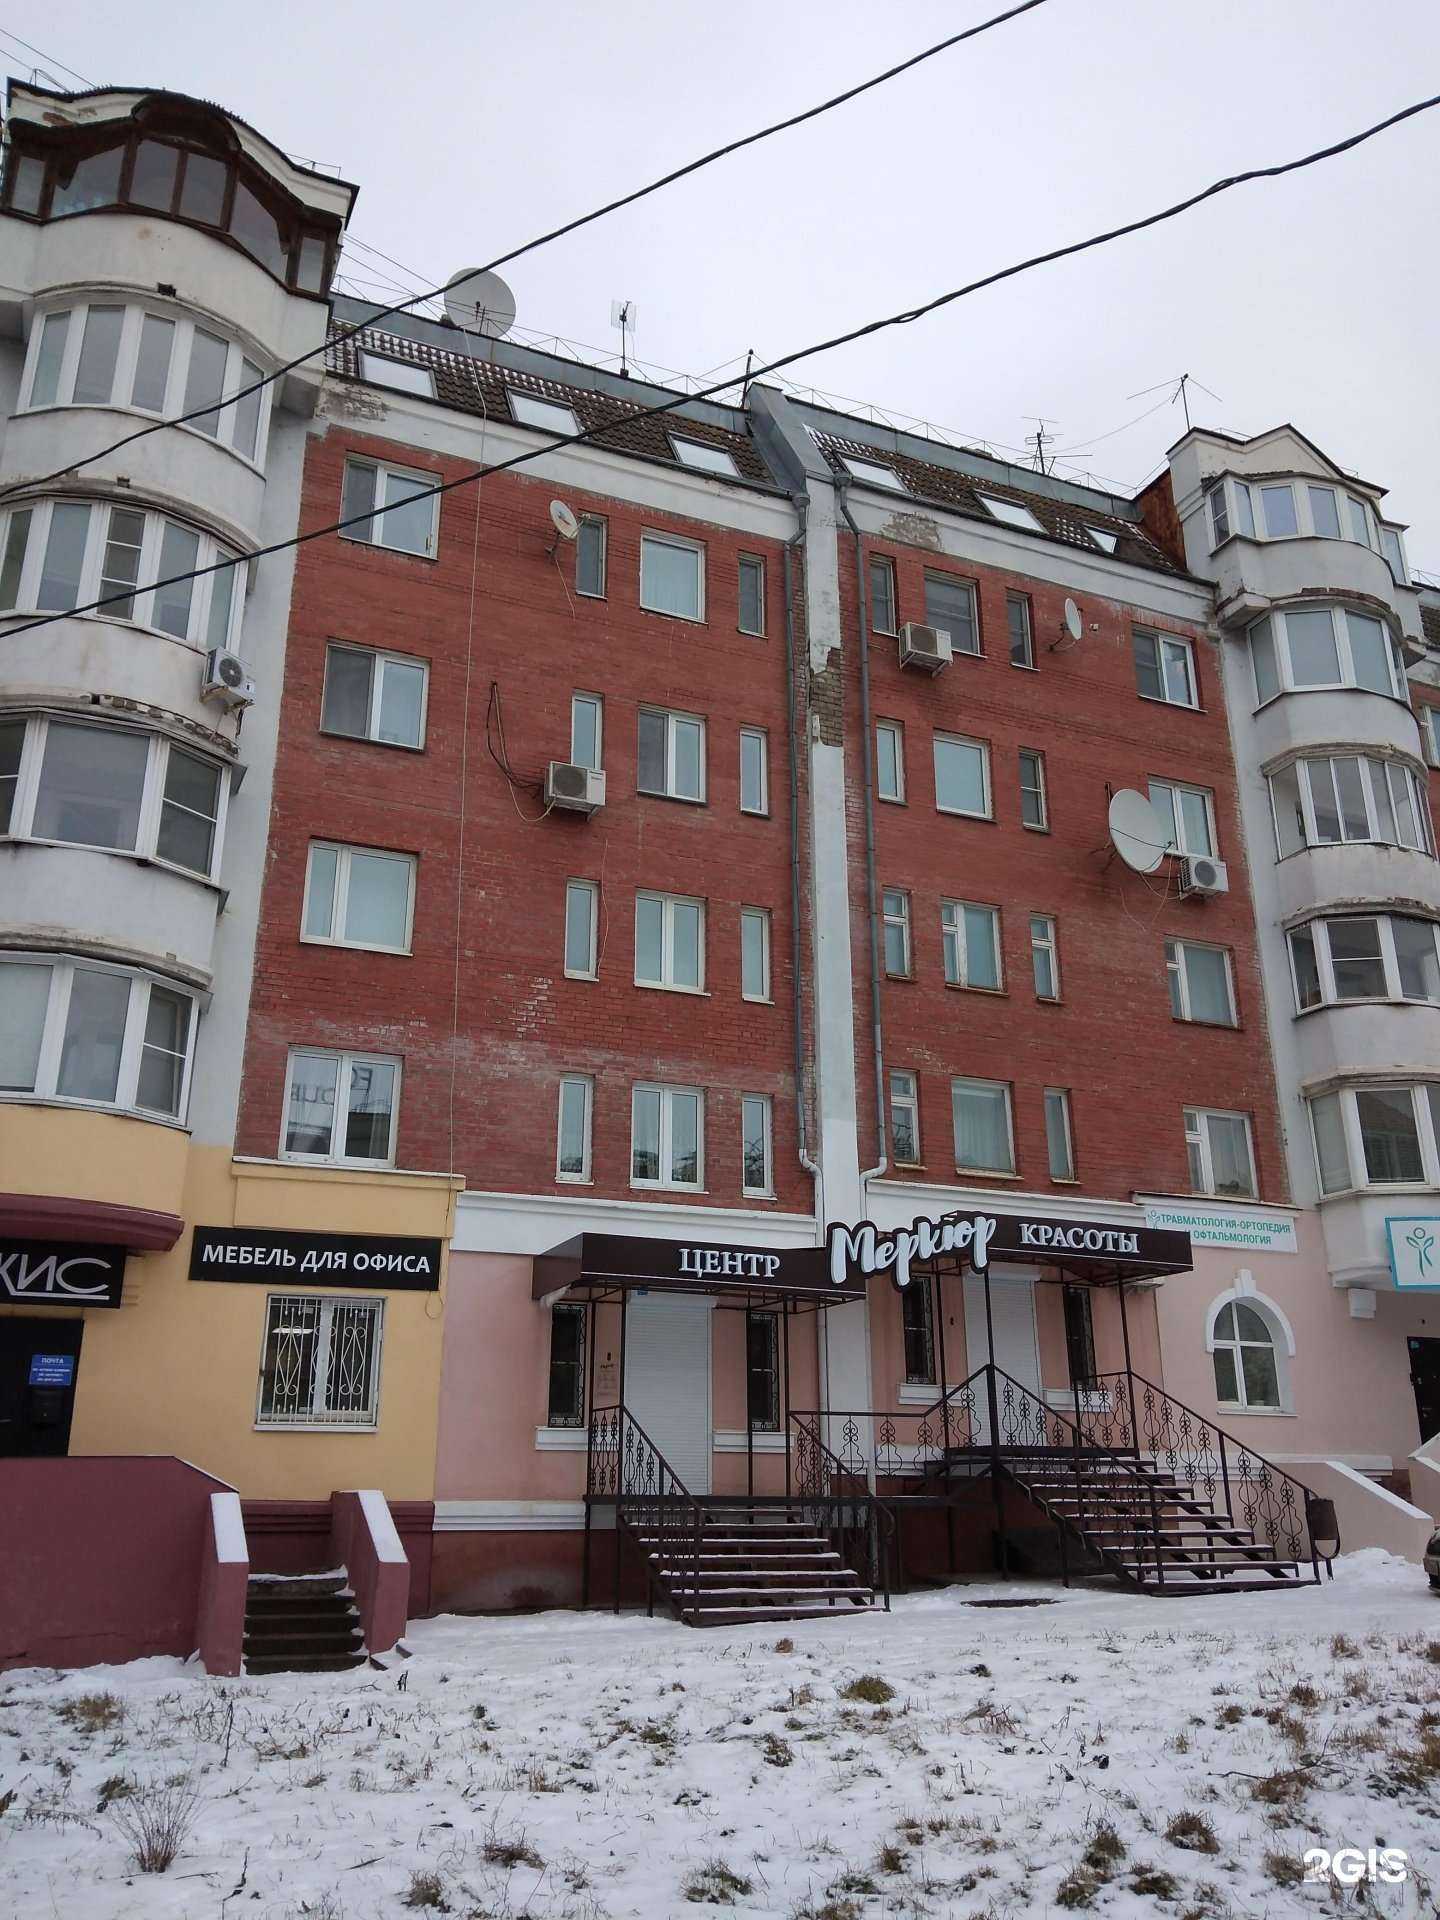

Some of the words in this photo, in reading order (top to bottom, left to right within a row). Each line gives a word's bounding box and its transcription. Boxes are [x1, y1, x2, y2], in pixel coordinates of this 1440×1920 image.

[1161, 1213, 1291, 1233] ТРАВМАТОЛОГИЯ-ОРТОПЕДИЯ
[1193, 1230, 1271, 1245] ОФТАЛЬМОЛОГИЯ
[830, 1216, 996, 1286] Меркюр
[1019, 1223, 1140, 1253] КРАСОТЫ
[203, 1244, 297, 1267] МЕБЕЛЬ
[300, 1250, 347, 1273] ДЛЯ
[352, 1253, 430, 1273] ОФИСА
[678, 1248, 781, 1279] ЦЕНТР
